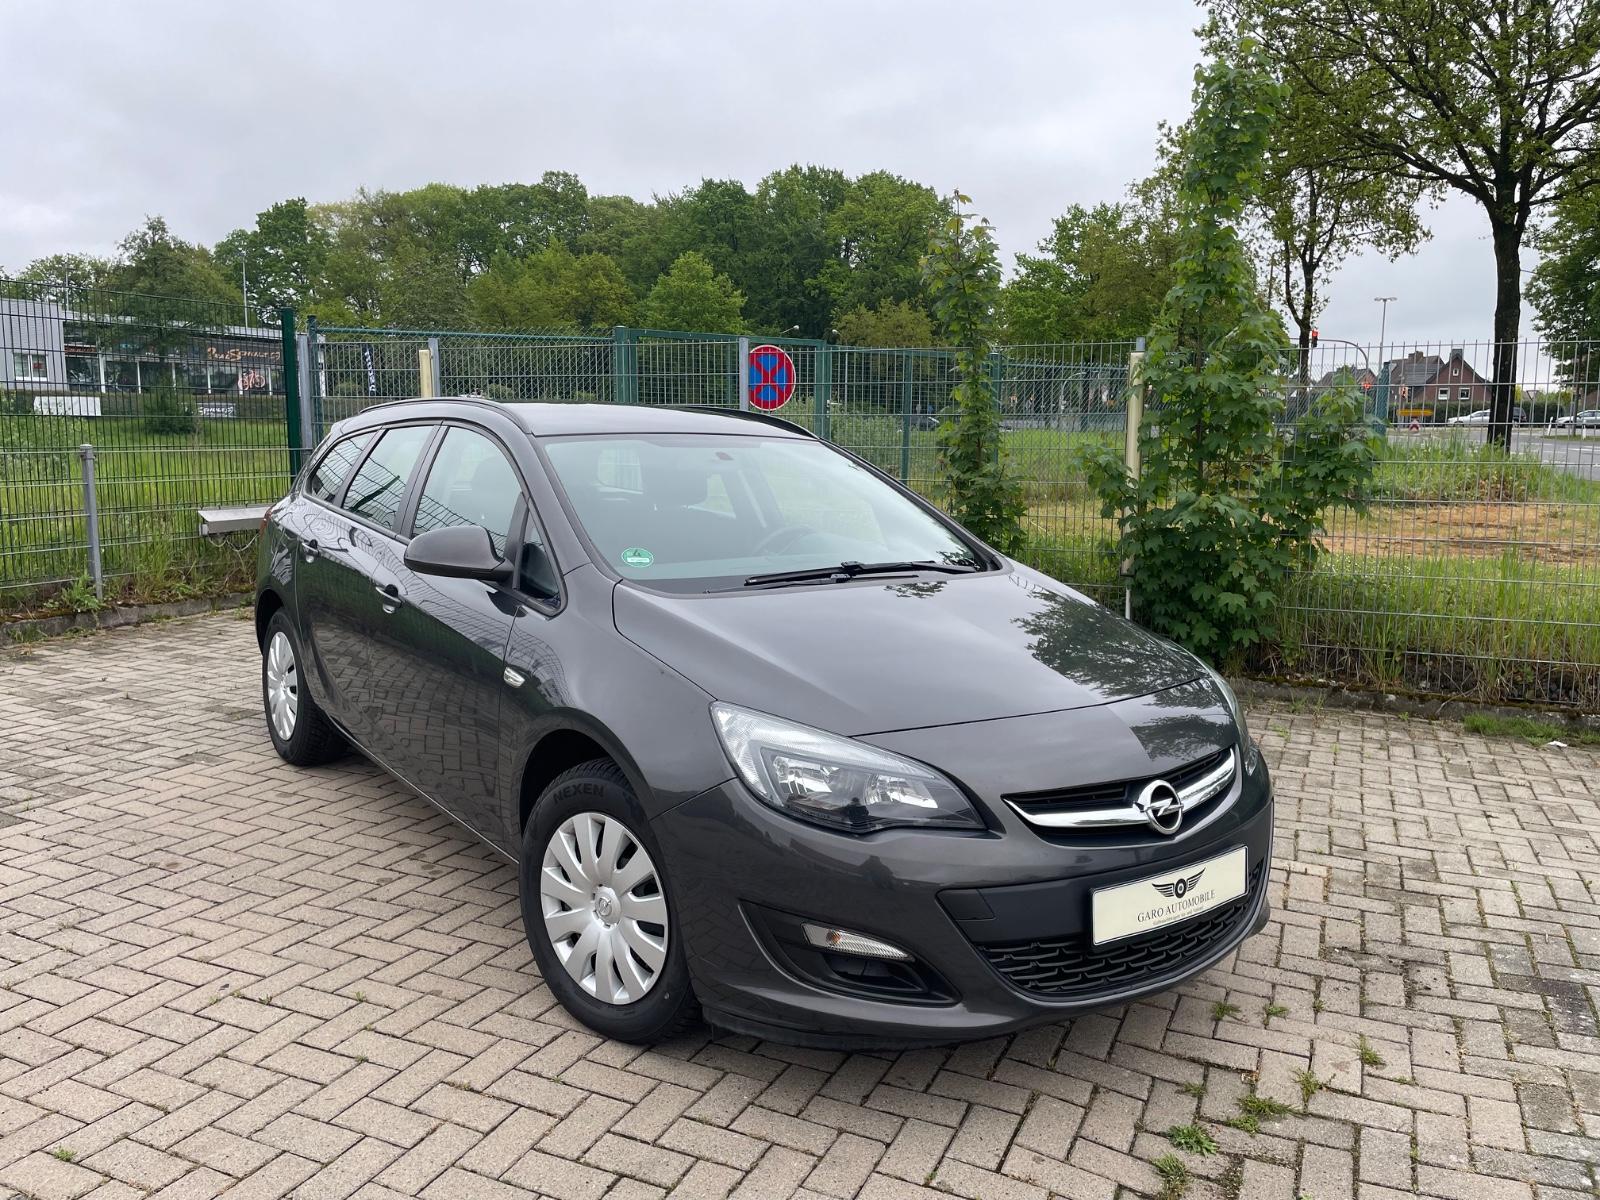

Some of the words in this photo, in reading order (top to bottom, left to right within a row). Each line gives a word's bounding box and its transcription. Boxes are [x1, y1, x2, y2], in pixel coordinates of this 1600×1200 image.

[553, 783, 604, 804] NEXEN
[1137, 907, 1164, 922] GARO
[1165, 889, 1215, 914] AUTOMOBILE
